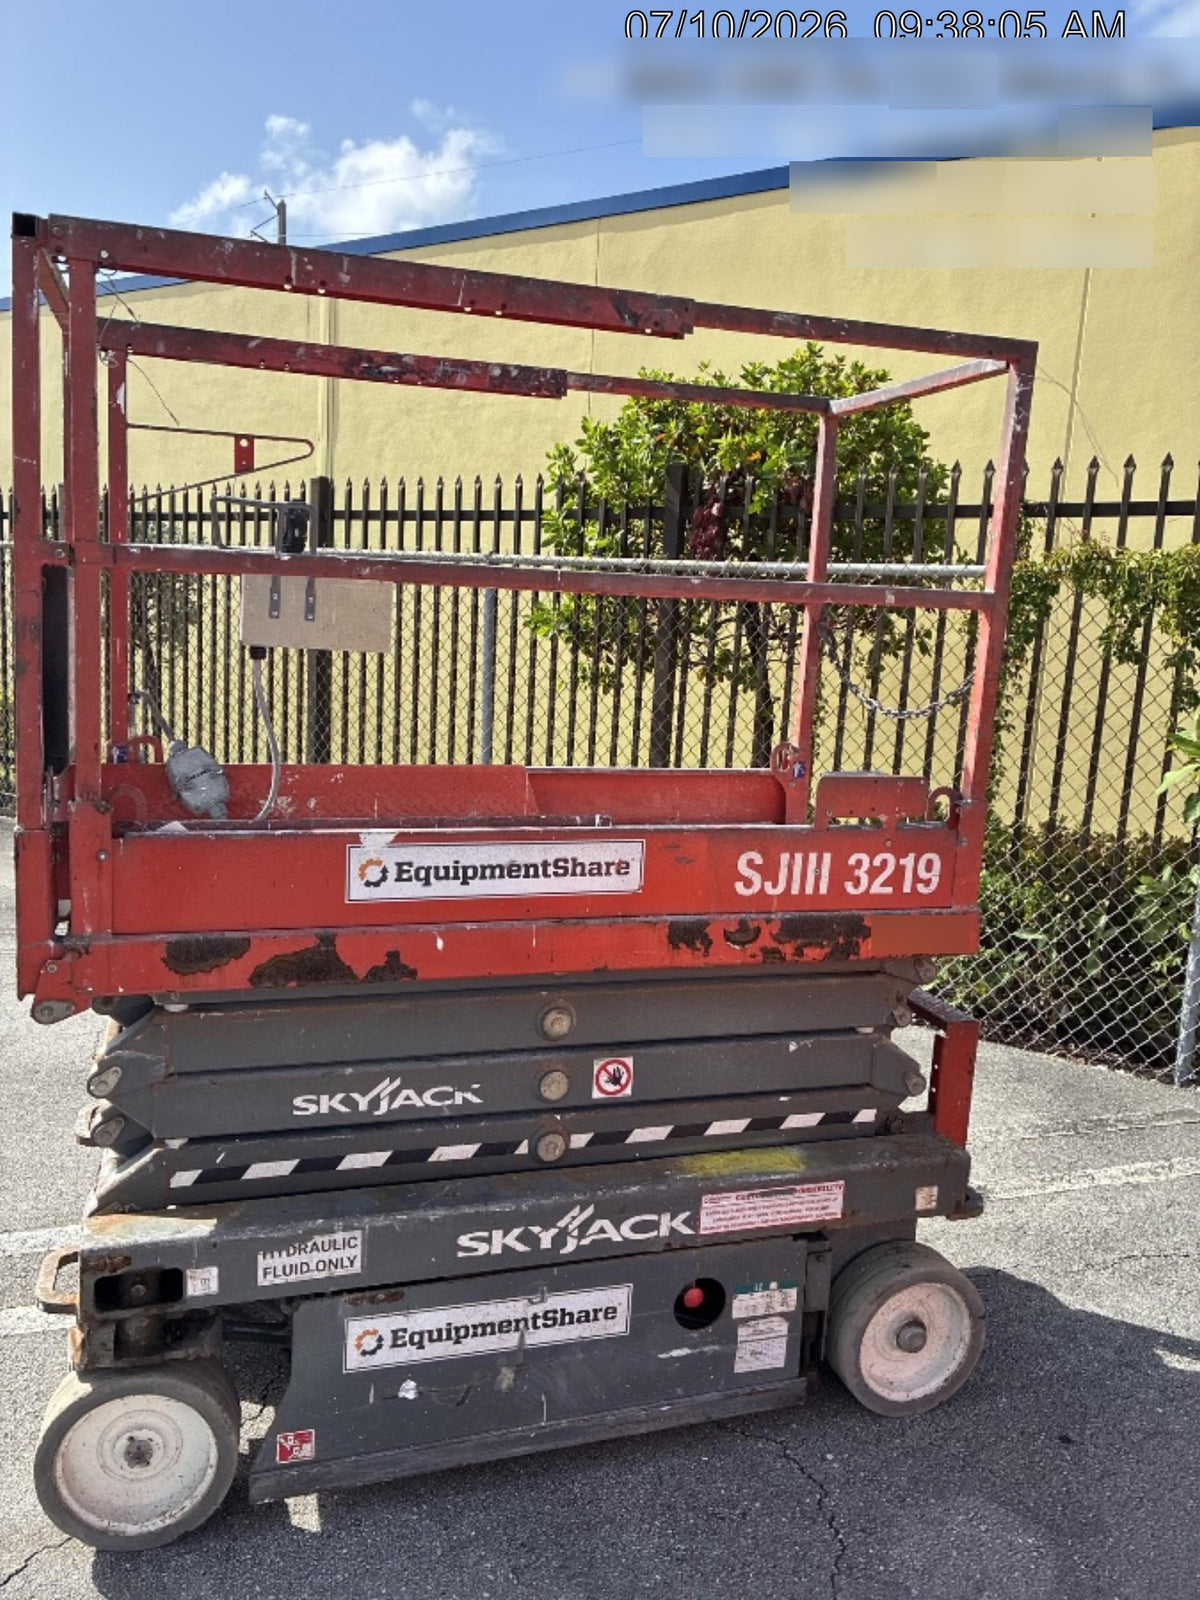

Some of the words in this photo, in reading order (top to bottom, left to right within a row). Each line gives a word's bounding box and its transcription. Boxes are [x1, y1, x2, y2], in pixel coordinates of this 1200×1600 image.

[394, 857, 630, 887] EquipmentShare
[734, 850, 831, 896] SJIII
[844, 852, 942, 895] 3219
[292, 1076, 484, 1115] SKYJACK
[456, 1202, 696, 1258] SKYJACK
[263, 1260, 310, 1279] FLUID
[315, 1254, 358, 1272] ONLY
[390, 1304, 618, 1349] EquipmentShare
